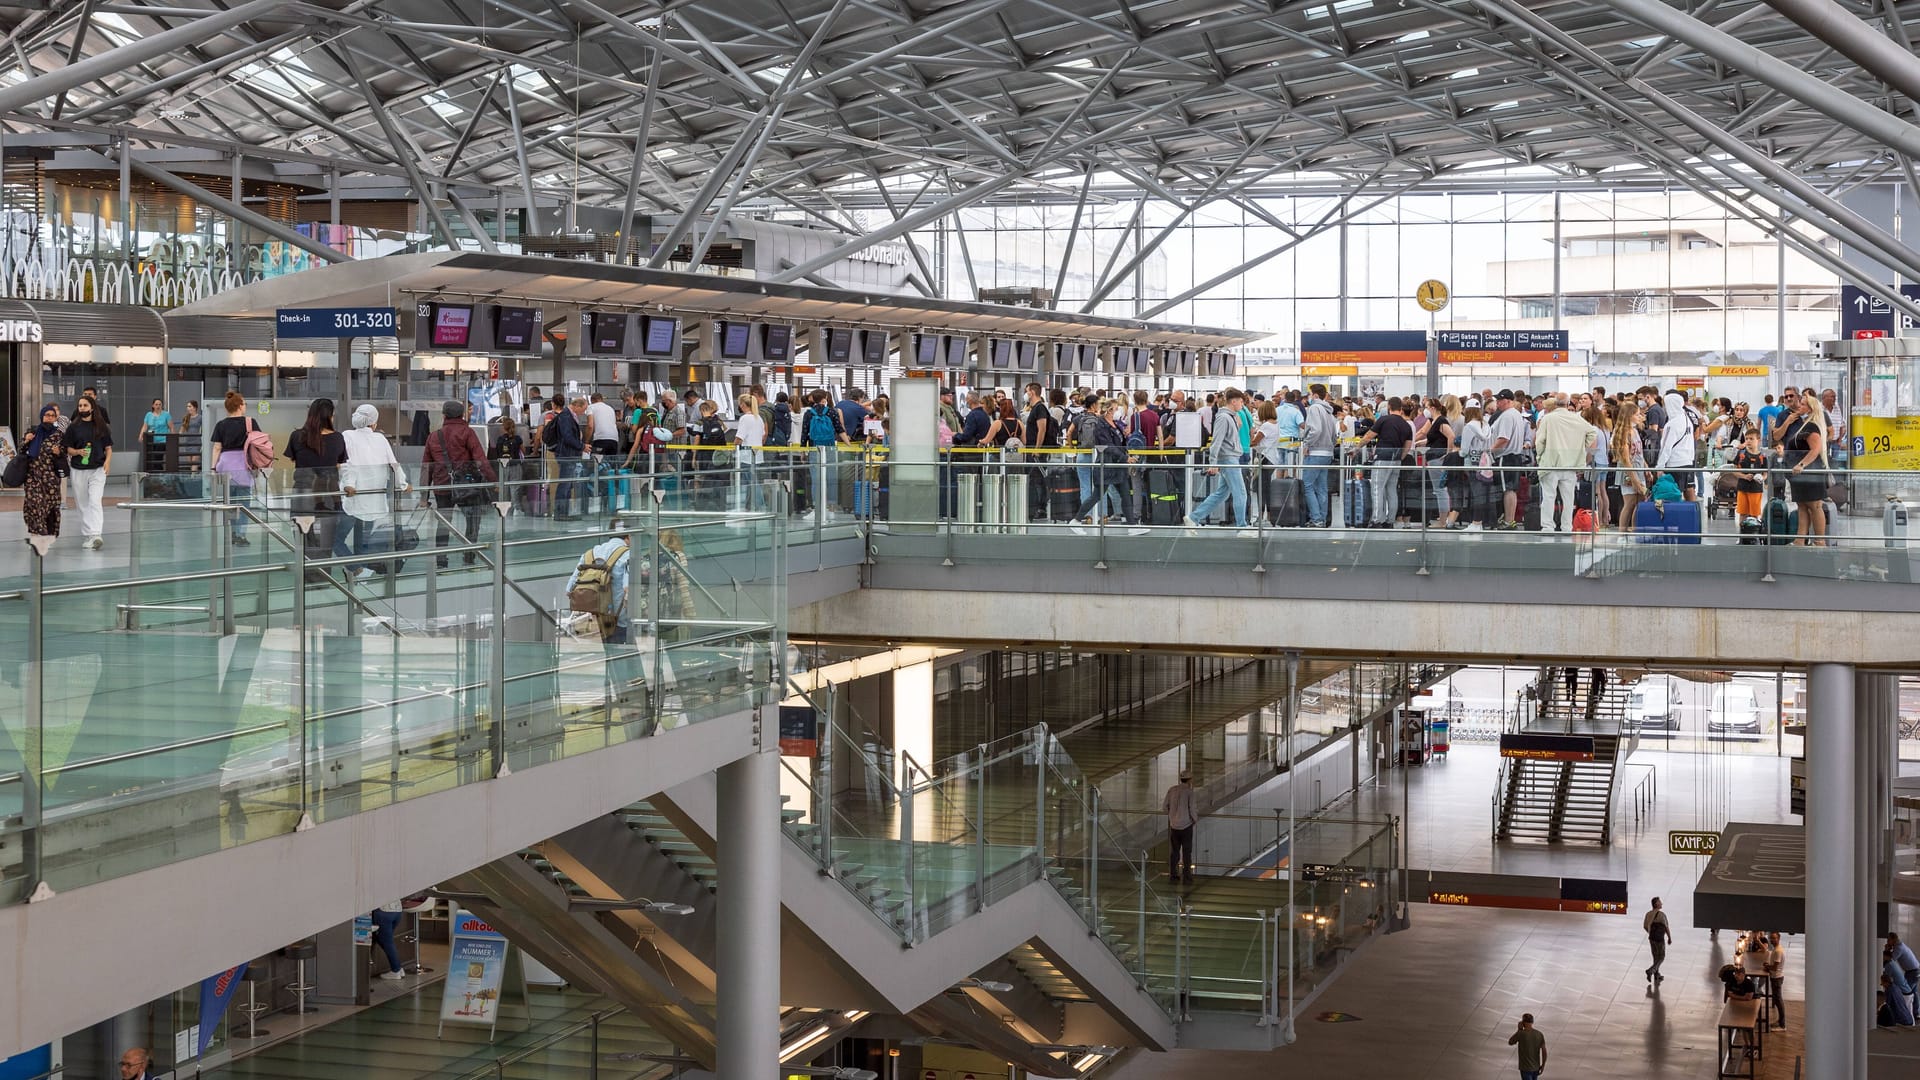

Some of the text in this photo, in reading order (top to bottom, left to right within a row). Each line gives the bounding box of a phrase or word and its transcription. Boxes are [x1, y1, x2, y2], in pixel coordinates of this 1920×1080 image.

[418, 305, 430, 317] 320
[280, 312, 392, 328] Check-in 301-320
[1674, 836, 1716, 849] KAMPUS
[462, 920, 496, 932] alltou
[462, 948, 491, 956] NUMMER
